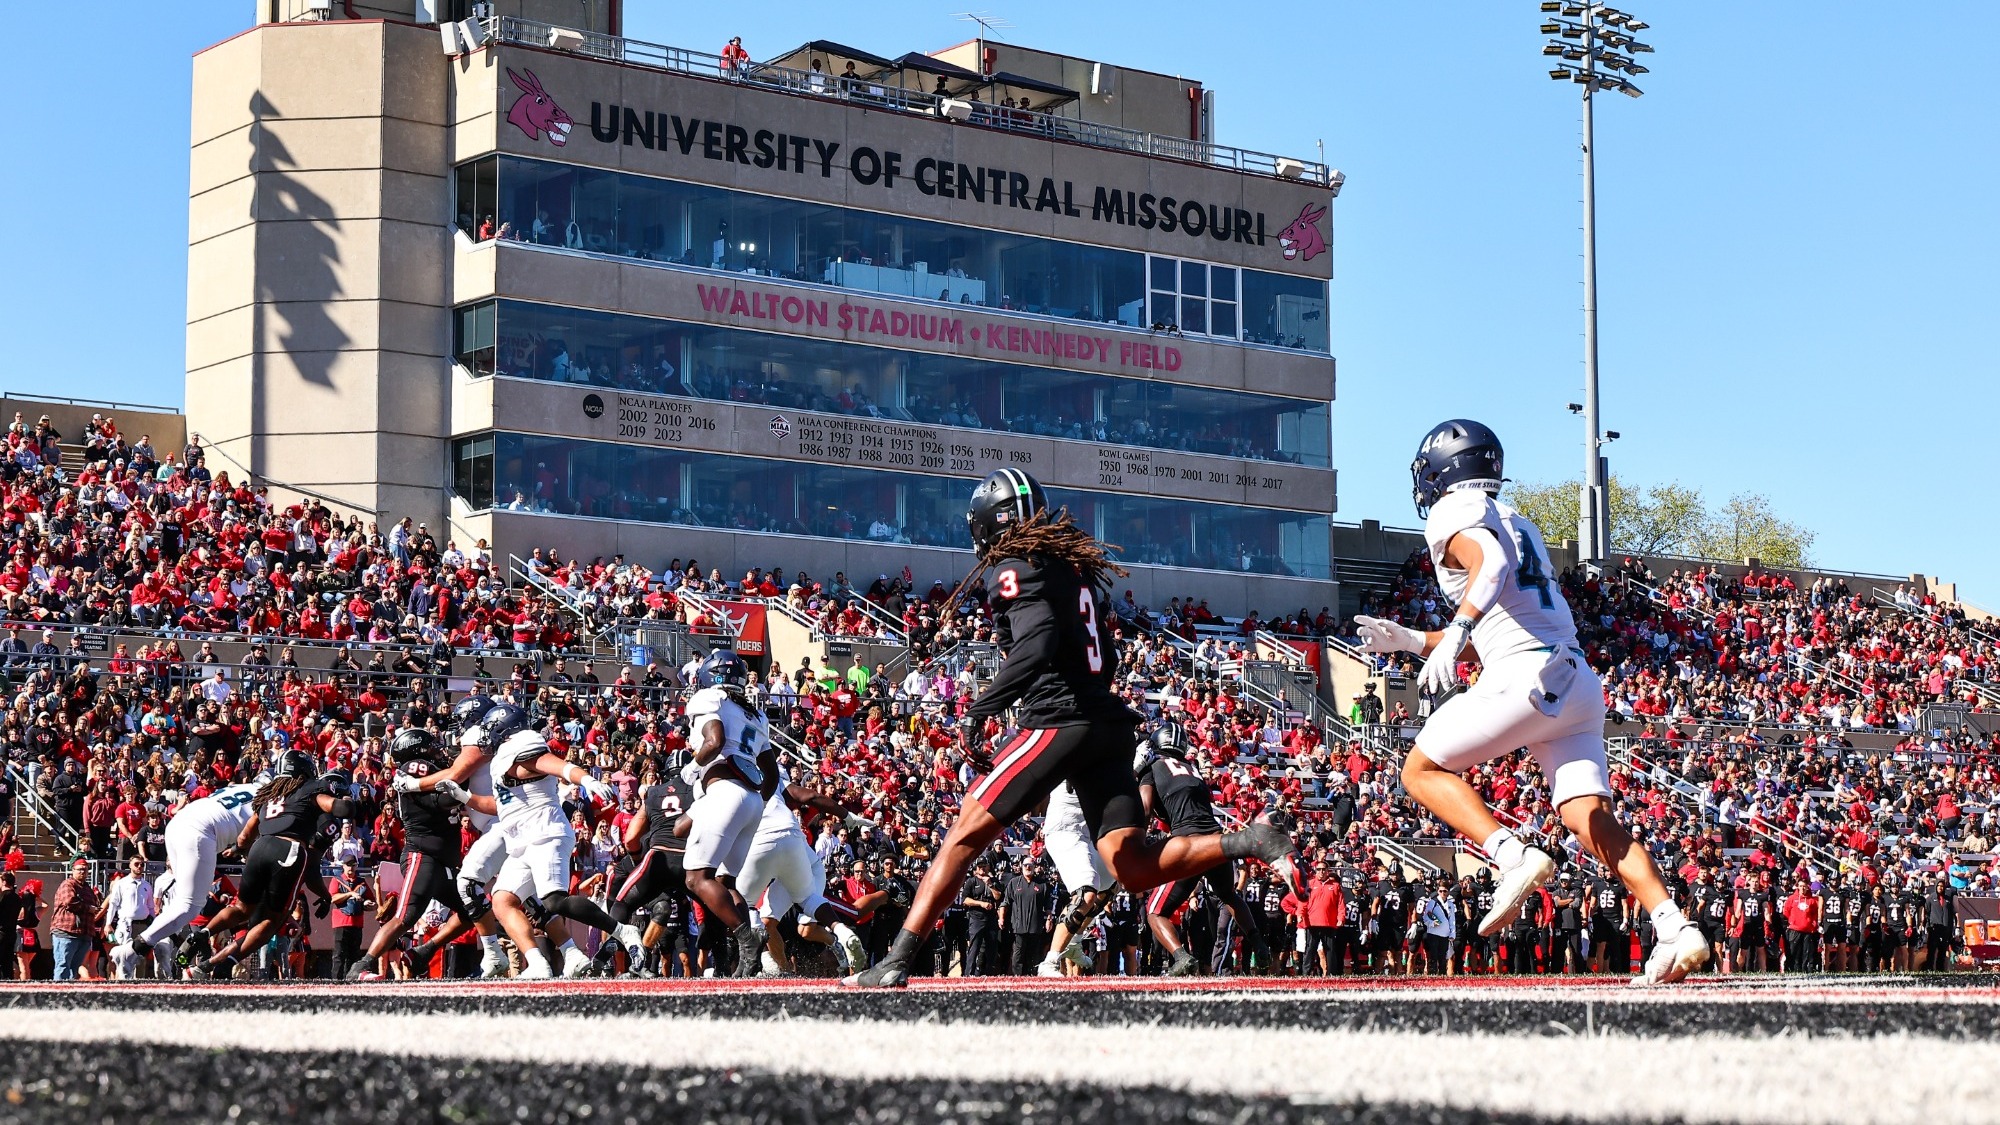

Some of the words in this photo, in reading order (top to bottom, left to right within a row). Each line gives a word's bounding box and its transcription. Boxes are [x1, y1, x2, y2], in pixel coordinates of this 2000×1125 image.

[590, 101, 840, 178] UNIVERSITY
[850, 146, 902, 188] OF
[914, 157, 1081, 218] CENTRAL
[1092, 186, 1266, 246] MISSOURI
[697, 284, 828, 327] WALTON
[838, 302, 965, 344] STADIUM
[986, 323, 1113, 362] KENNEDY
[1120, 341, 1183, 372] FIELD
[584, 404, 602, 413] NCAA
[619, 397, 647, 409] NCAA
[650, 400, 693, 413] PLAYOFFS
[619, 409, 648, 423] 2002
[654, 412, 682, 427] 2010
[688, 416, 716, 431] 2016
[770, 422, 790, 433] MIAA
[798, 416, 822, 428] MIAA
[824, 419, 882, 434] CONFERENCE
[884, 426, 937, 440] CHAMPIONS
[619, 424, 646, 438] 2019
[654, 428, 682, 442] 2023
[798, 428, 823, 442] 1912
[830, 432, 854, 445] 1913
[860, 435, 884, 448] 1914
[890, 438, 914, 451] 1915
[920, 441, 944, 454] 1926
[950, 444, 974, 458] 1956
[980, 448, 1003, 460] 1970
[1009, 450, 1032, 464] 1983
[1421, 431, 1445, 454] 44
[799, 443, 823, 456] 1986
[828, 446, 851, 459] 1987
[858, 449, 882, 462] 1988
[888, 452, 914, 466] 2003
[920, 456, 944, 468] 2019
[950, 458, 975, 472] 2023
[1098, 449, 1122, 460] BOWL
[1122, 452, 1150, 462] GAMES
[1484, 450, 1496, 460] 44
[1100, 460, 1120, 472] 1950
[1126, 463, 1148, 476] 1968
[1154, 466, 1176, 478] 1970
[1180, 469, 1202, 481] 2001
[1208, 472, 1229, 484] 2011
[1236, 474, 1257, 487] 2014
[1262, 478, 1283, 490] 2017
[1100, 474, 1122, 486] 2024
[999, 569, 1020, 599] 3
[1079, 585, 1103, 674] 3
[408, 762, 428, 776] 99
[1246, 886, 1260, 902] 31
[1384, 894, 1401, 910] 73
[1600, 894, 1615, 908] 85
[1115, 896, 1131, 911] 14
[1710, 903, 1725, 917] 46
[1826, 901, 1840, 914] 38
